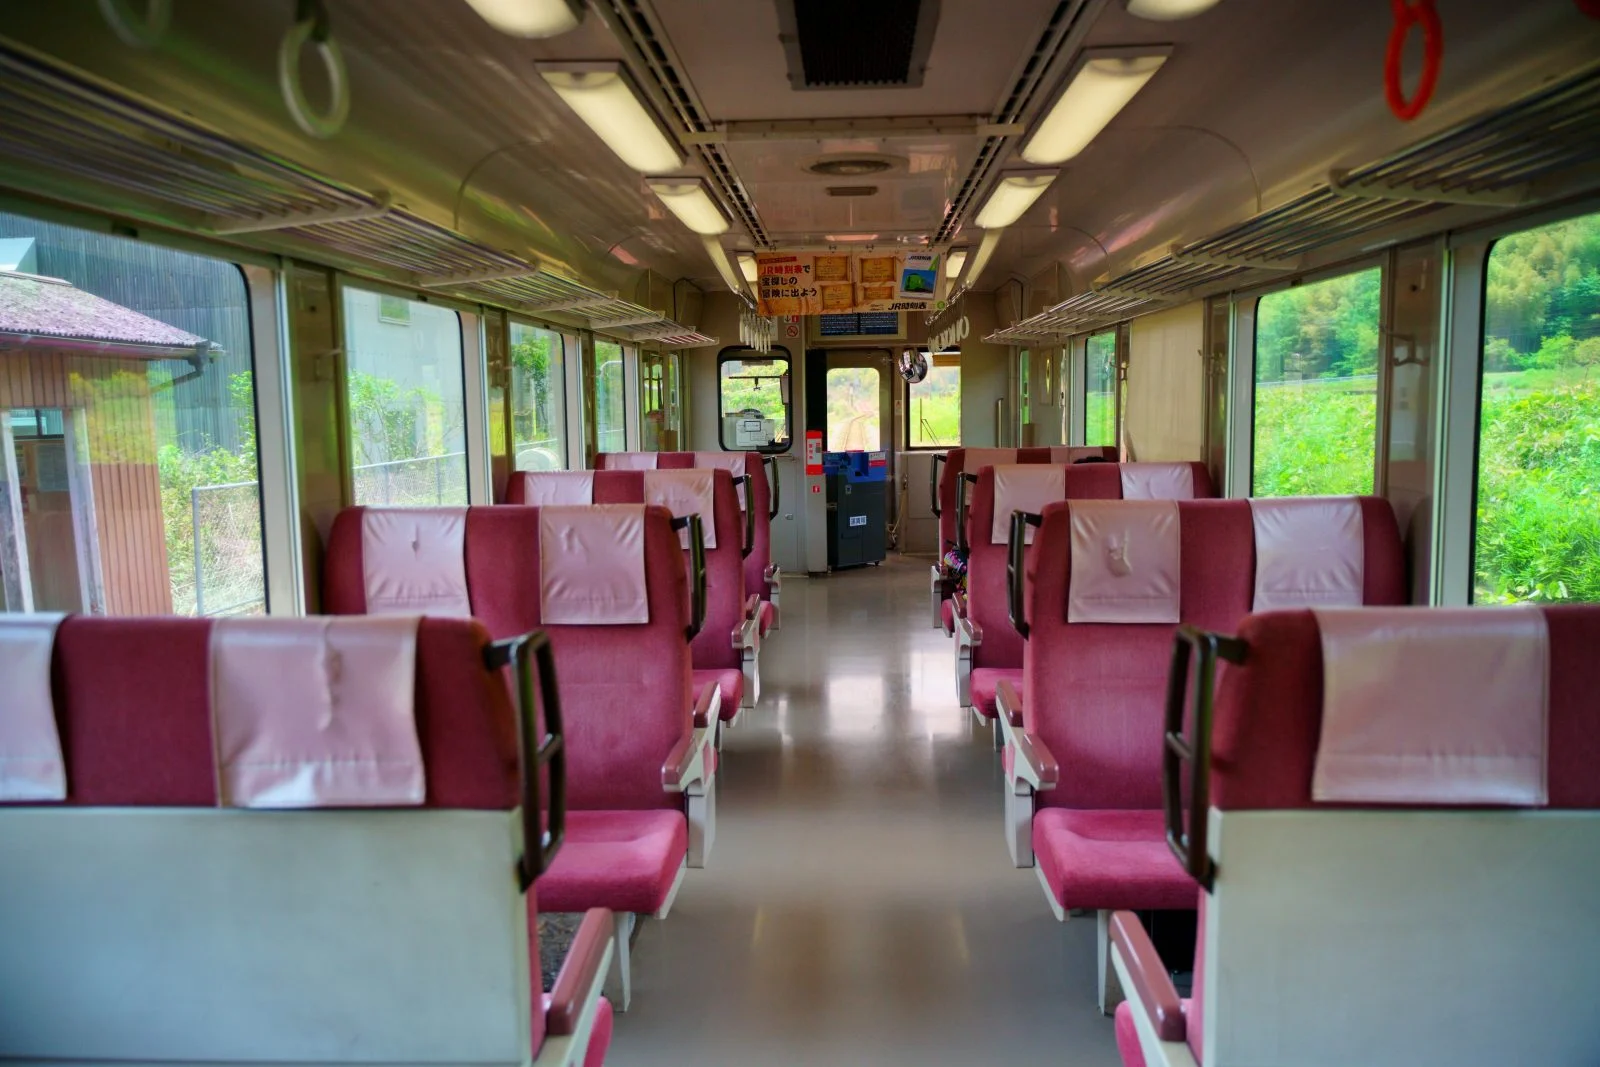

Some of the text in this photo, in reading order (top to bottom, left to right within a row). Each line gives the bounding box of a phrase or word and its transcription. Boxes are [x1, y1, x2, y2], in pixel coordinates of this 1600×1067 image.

[760, 264, 811, 275] JR時刻表で
[762, 276, 798, 287] 宝探しの
[762, 288, 818, 299] 冒険に出よう
[887, 302, 927, 310] JR時刻表
